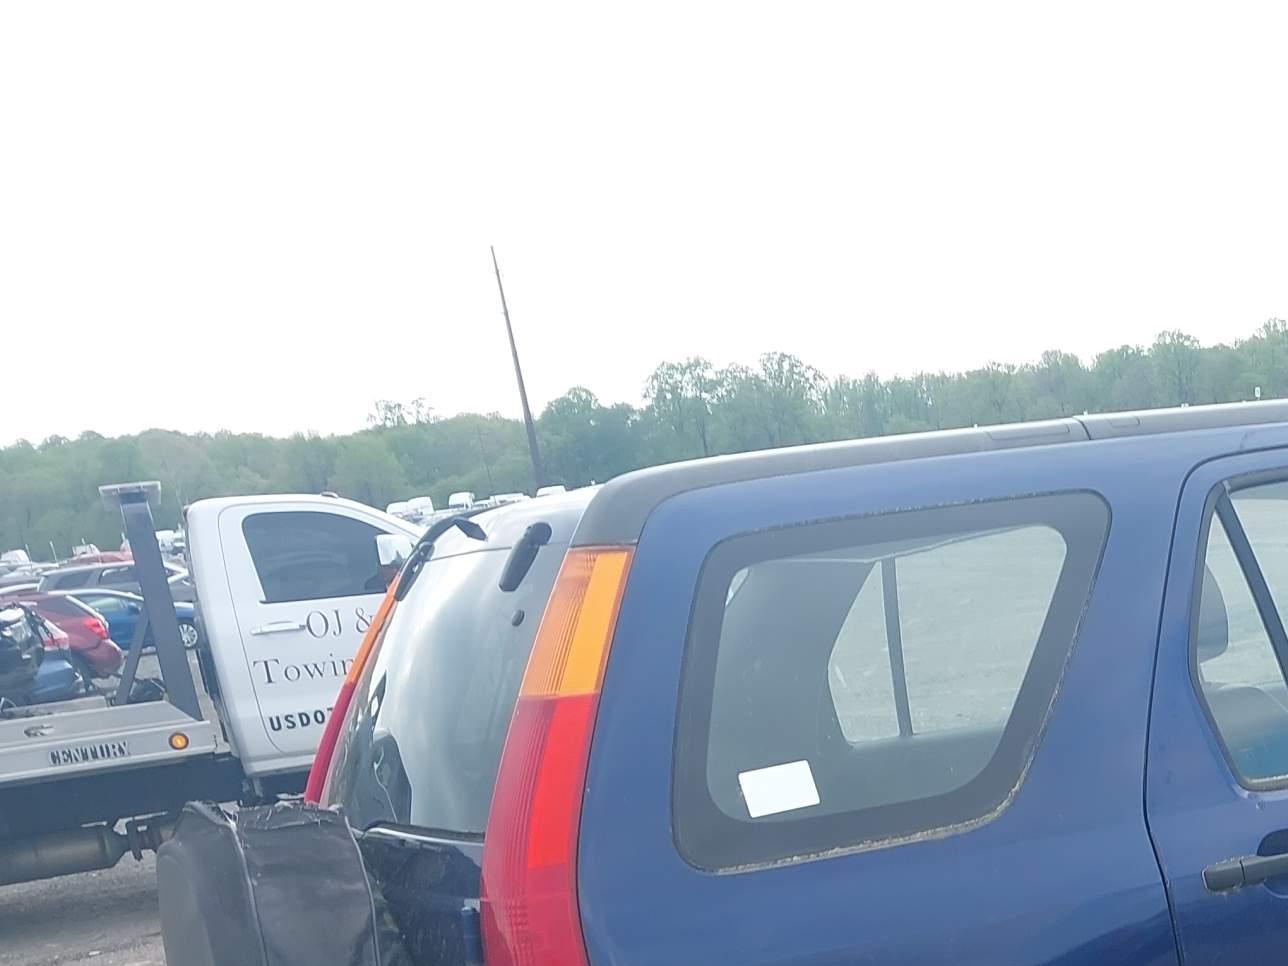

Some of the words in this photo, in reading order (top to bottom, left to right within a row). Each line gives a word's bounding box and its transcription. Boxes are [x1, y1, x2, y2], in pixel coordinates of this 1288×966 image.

[306, 609, 342, 639] OJ
[252, 652, 355, 684] Towin
[49, 740, 129, 765] CENTURY
